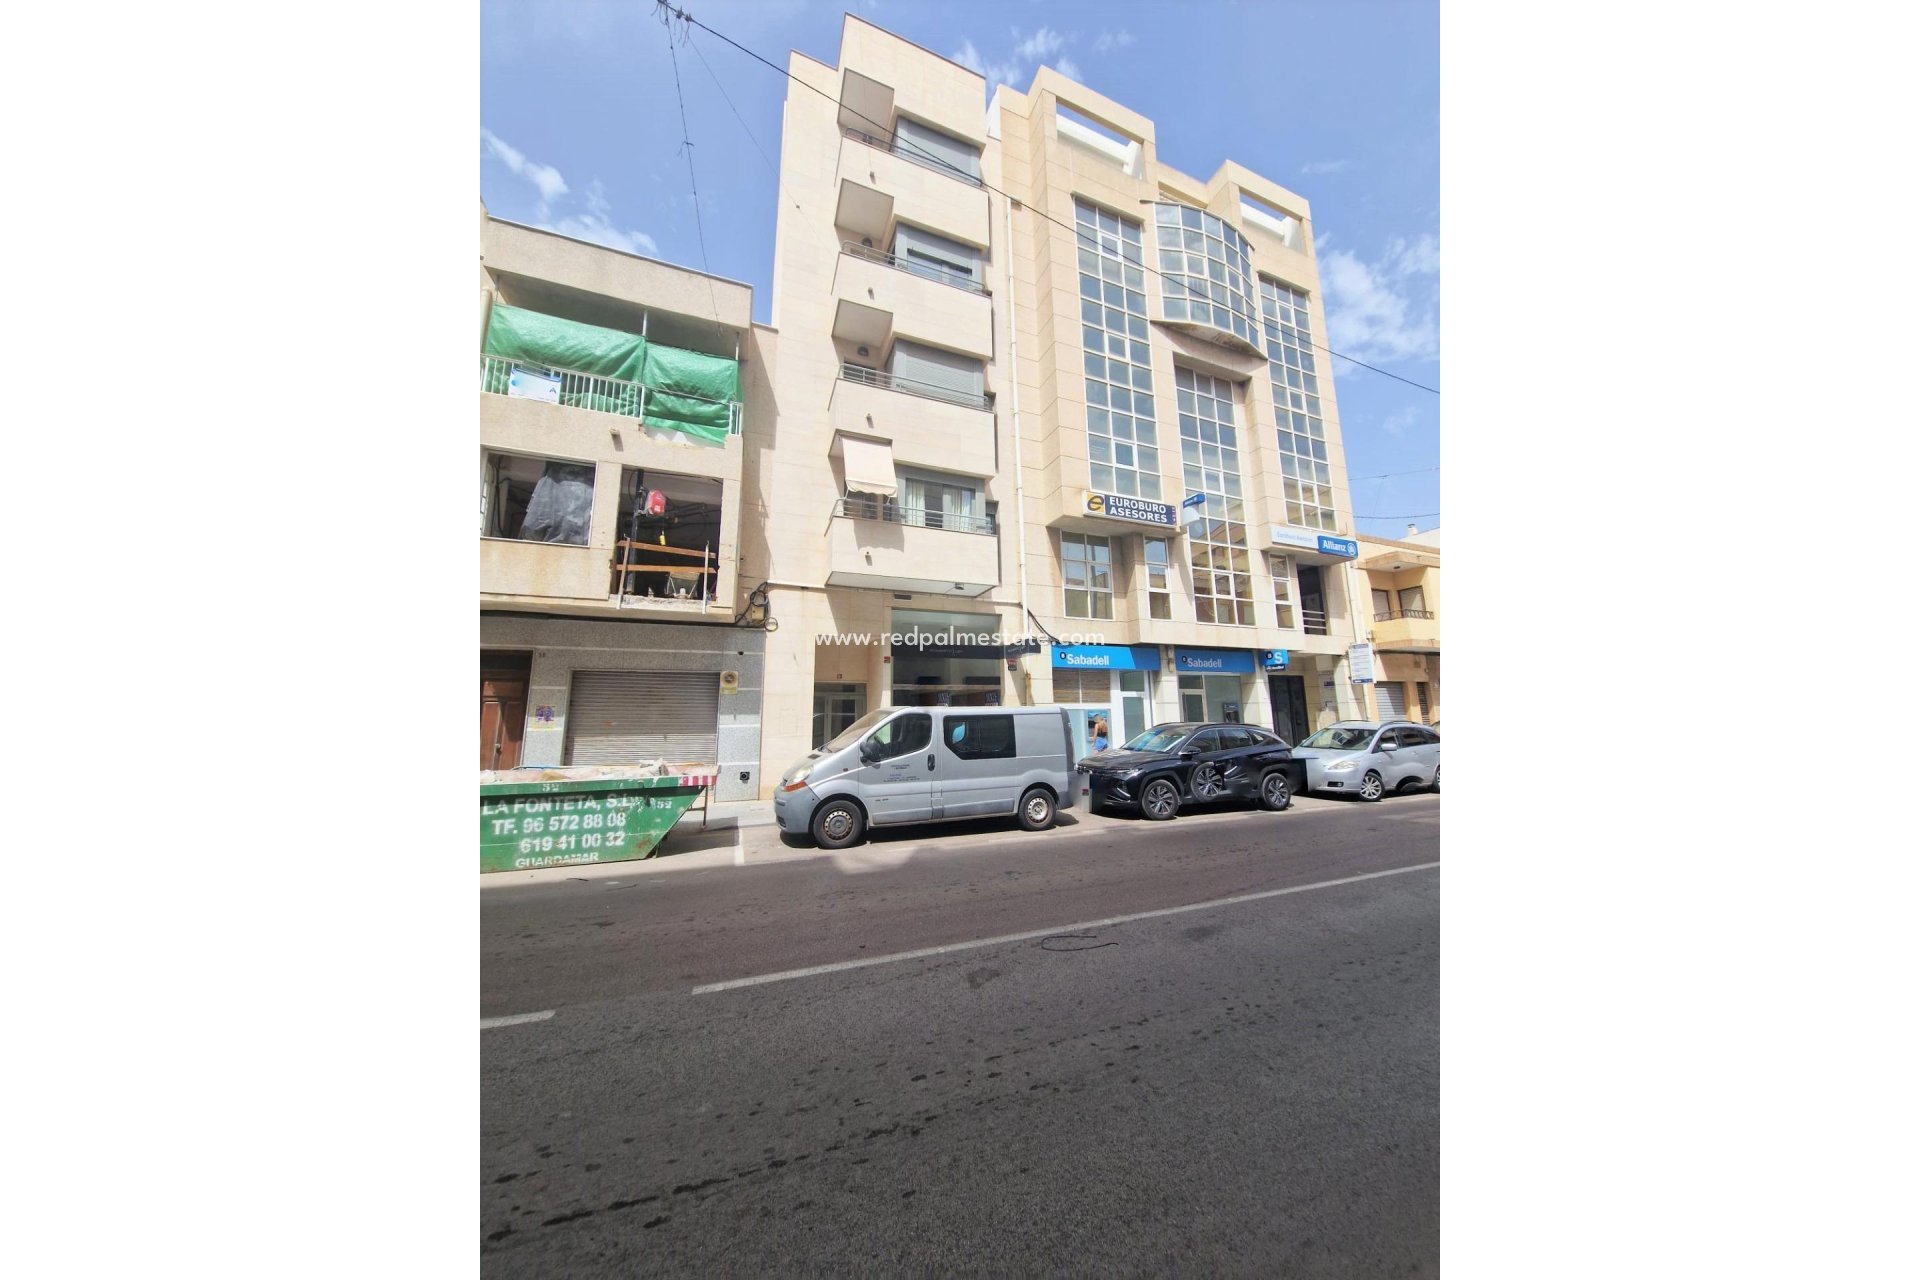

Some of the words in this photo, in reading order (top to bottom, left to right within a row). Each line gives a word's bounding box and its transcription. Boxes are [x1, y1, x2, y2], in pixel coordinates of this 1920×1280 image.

[1109, 497, 1166, 514] EUROBURO
[1109, 507, 1168, 523] ASESORES
[1323, 539, 1347, 552] Allianz
[1067, 653, 1110, 666] Sabadell
[1187, 657, 1222, 668] Sabadell
[1274, 652, 1283, 664] S
[482, 799, 509, 815] LA
[513, 794, 601, 814] FONTETA,
[491, 818, 518, 835] TF.
[523, 816, 544, 833] 96
[549, 814, 580, 831] 572
[583, 813, 603, 829] 88
[607, 809, 627, 827] 08
[520, 836, 553, 853] 619
[556, 834, 576, 850] 41
[582, 833, 601, 848] 00
[605, 831, 626, 846] 32
[516, 852, 599, 868] GUARDAMAR
